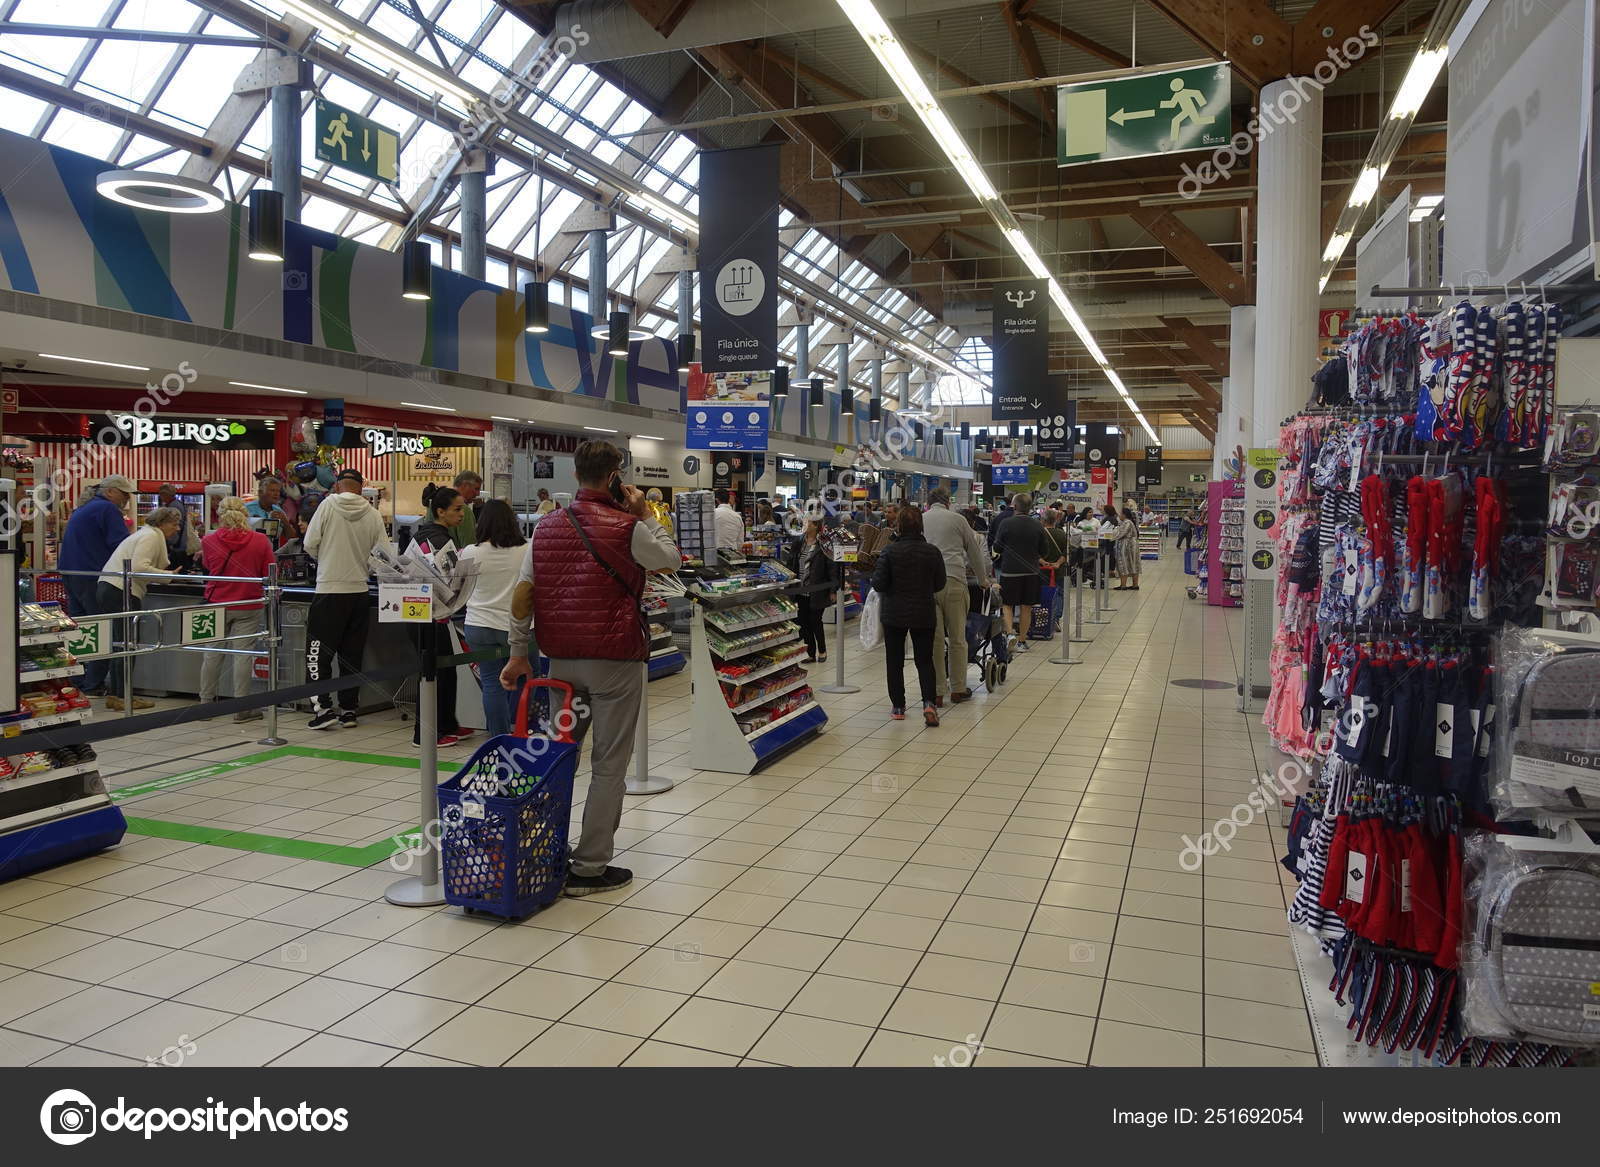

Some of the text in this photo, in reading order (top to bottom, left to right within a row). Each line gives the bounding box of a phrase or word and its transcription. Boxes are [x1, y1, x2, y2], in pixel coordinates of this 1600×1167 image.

[717, 339, 759, 349] Fila única
[718, 353, 758, 362] Single queue
[307, 640, 320, 680] adidas
[1564, 751, 1590, 766] Top
